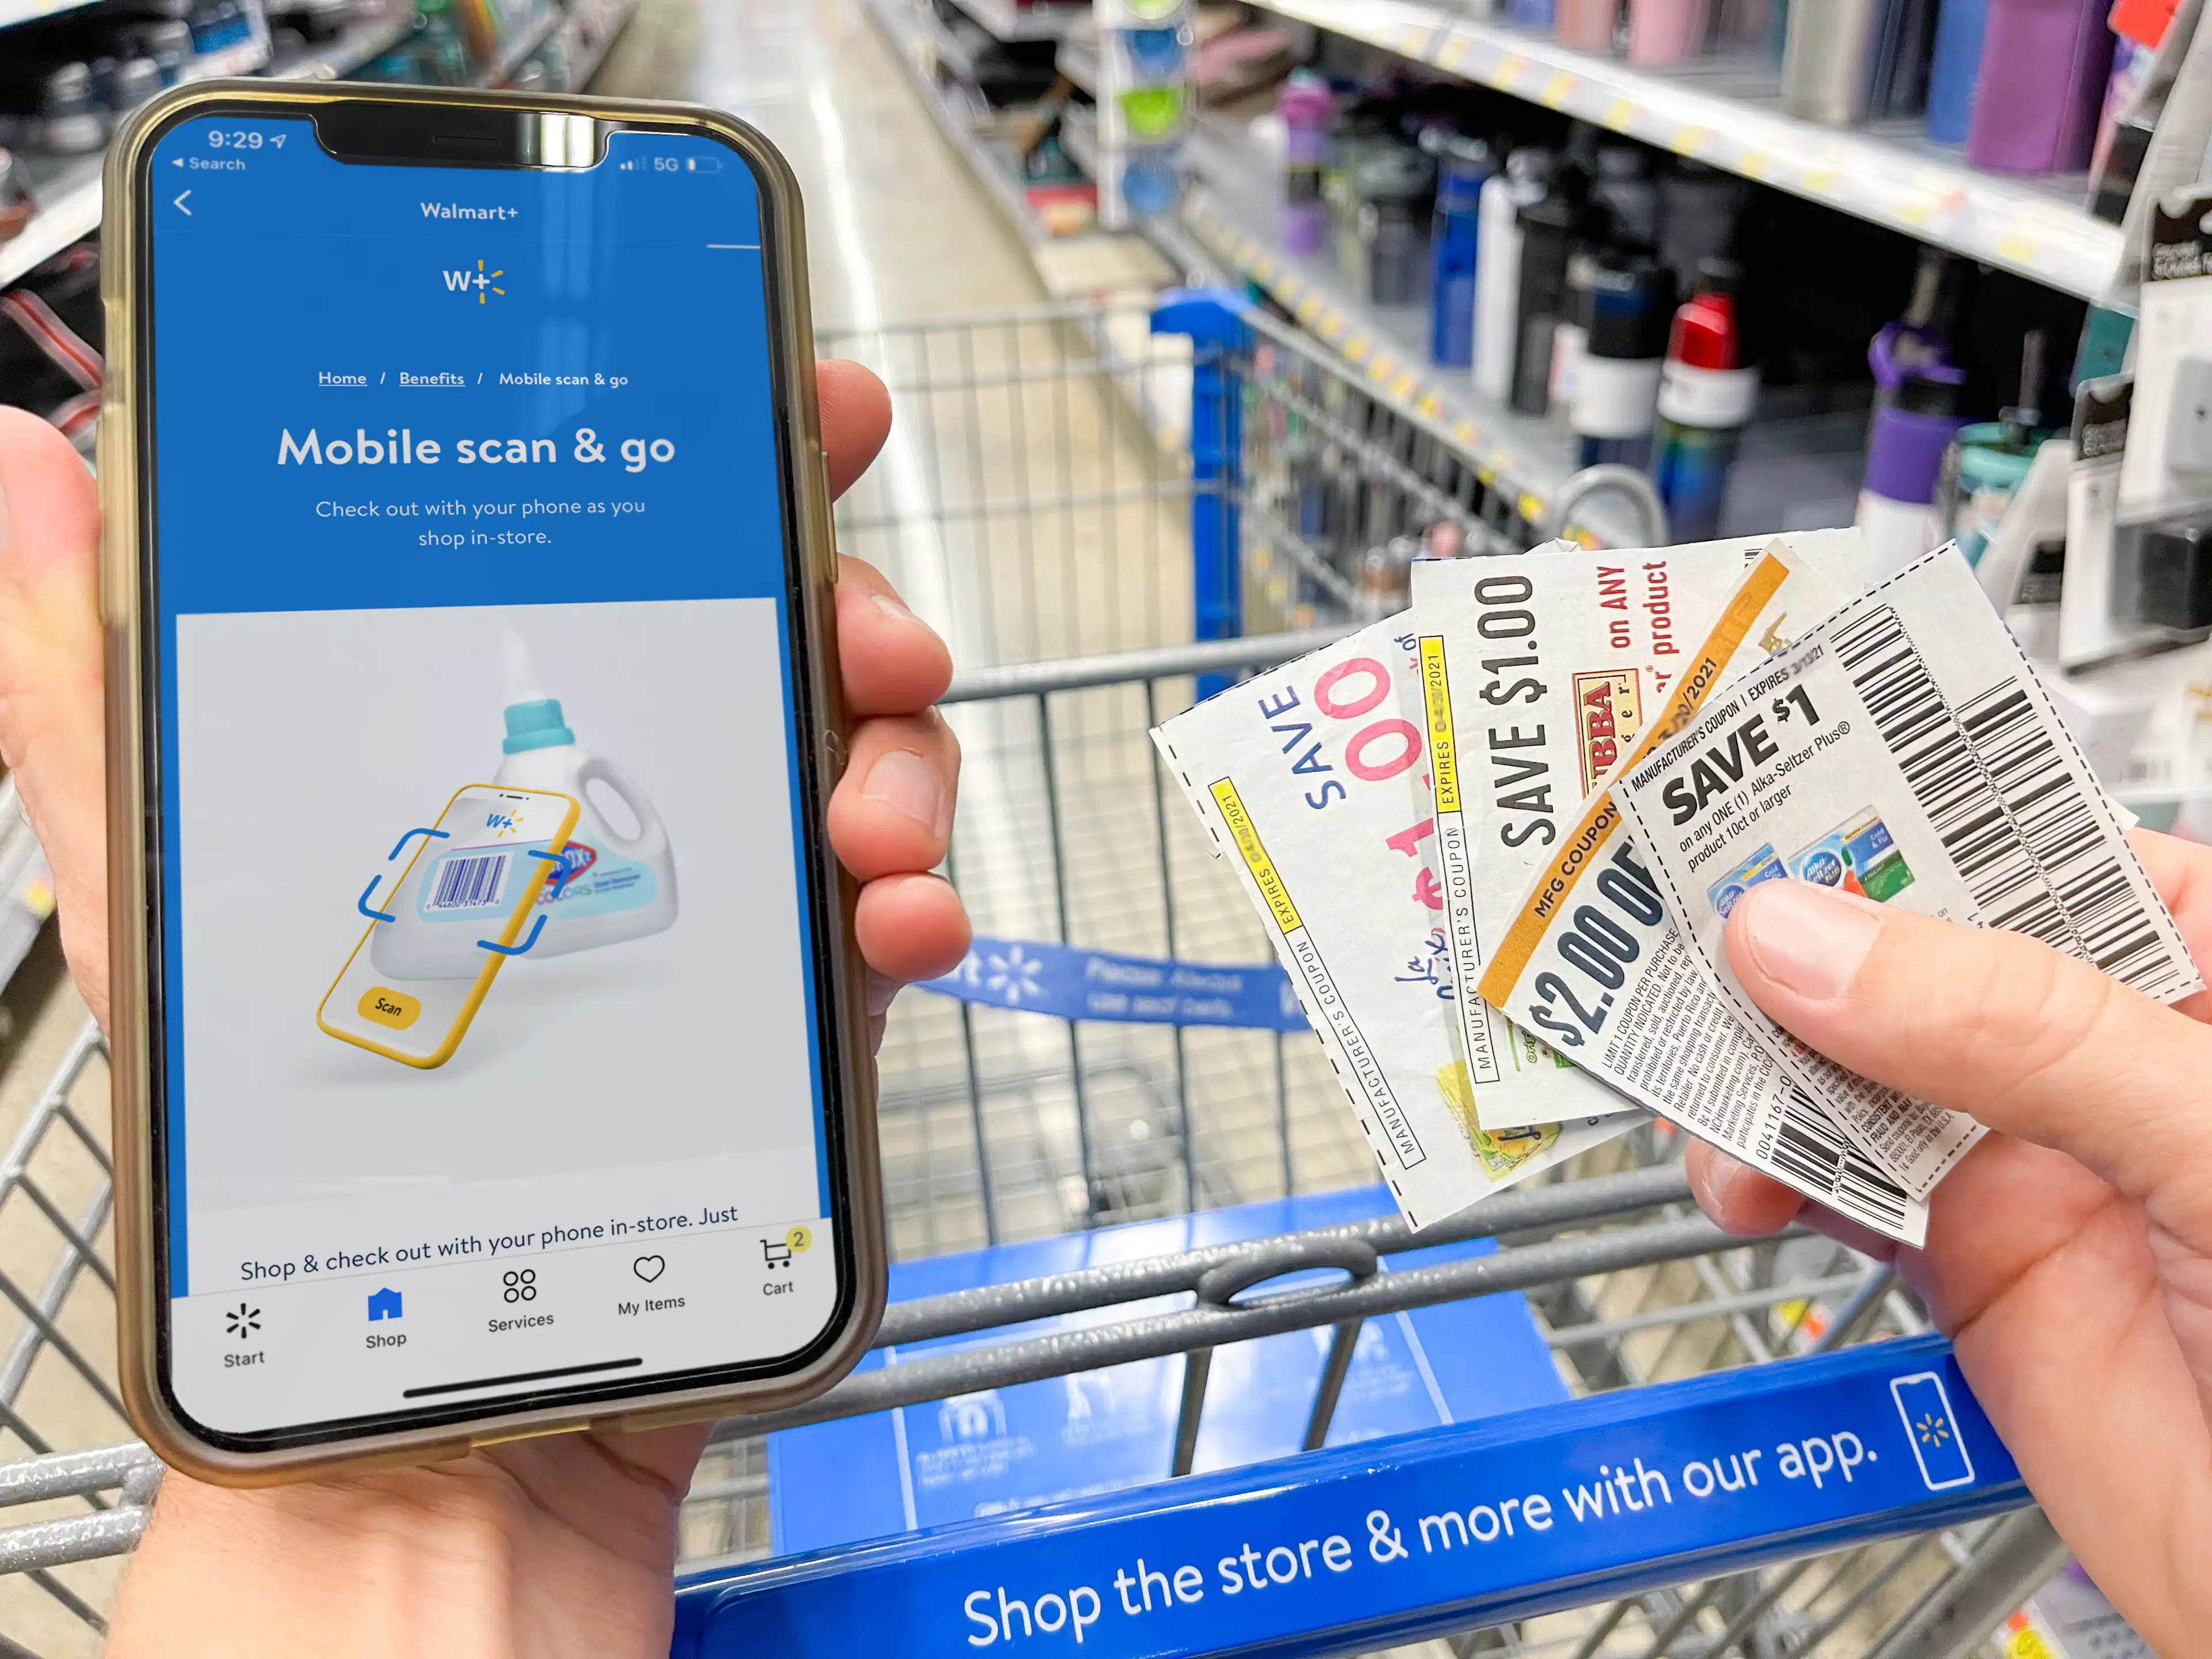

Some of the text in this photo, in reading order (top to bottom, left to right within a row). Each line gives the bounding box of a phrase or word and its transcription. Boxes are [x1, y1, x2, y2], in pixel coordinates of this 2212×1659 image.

[190, 157, 245, 170] Search
[209, 131, 263, 149] 9:29
[654, 157, 678, 171] 5G
[421, 203, 518, 219] Walmart+
[319, 372, 628, 388] Home Benefits Mobile scan & go
[278, 429, 675, 472] Mobile scan & go
[316, 499, 644, 519] Check out with your phone as you
[419, 530, 551, 550] shop in-store.
[1596, 566, 1629, 610] ANY
[1642, 560, 1680, 654] product
[1609, 620, 1631, 649] on
[1474, 575, 1556, 847] SAVE $1.00
[1631, 727, 1705, 791] MANUFACTURER'S
[1705, 700, 1740, 733] COUPON
[1748, 668, 1789, 701] EXPIRES
[1258, 685, 1346, 809] SAVE
[1440, 741, 1454, 805] EXPIRES
[1663, 714, 1779, 825] SAVE
[1772, 684, 1820, 726] $1
[1680, 837, 1693, 851] on
[1694, 821, 1711, 840] any
[1713, 801, 1734, 825] ONE
[1734, 791, 1748, 810] (1)
[1752, 746, 1813, 796] Alka-Seltzer
[1688, 785, 1790, 873] product 10ct or larger
[1446, 827, 1471, 899] COUPON
[1535, 801, 1618, 917] MFG COUPON
[1260, 869, 1294, 924] EXPIRES
[1297, 942, 1335, 1004] COUPON
[1528, 834, 1664, 1047] $2.00 OF
[375, 998, 402, 1016] Scan
[1457, 907, 1491, 1070] MANUFACTURER'S
[1602, 1041, 1619, 1068] LIMIT
[1618, 996, 1641, 1034] COUPON
[1635, 978, 1650, 997] PER
[1645, 928, 1679, 978] PURCHASE
[1615, 944, 1684, 1074] QUANTITY INDICATED. Not to be
[1627, 1036, 1654, 1082] transferred,
[1649, 1014, 1664, 1034] sold,
[1658, 972, 1684, 1013] auctioned,
[1641, 1046, 1662, 1091] prohibited
[1658, 1037, 1666, 1047] or
[1663, 997, 1684, 1036] restricted
[1679, 986, 1691, 997] by
[1652, 993, 1700, 1097] its territories, Puerto Rico
[1687, 1065, 1699, 1077] No
[1696, 1044, 1707, 1063] cash
[1704, 1032, 1711, 1043] or
[1708, 1007, 1724, 1032] credit
[1334, 1012, 1414, 1154] MANUFACTURER'S
[1663, 1028, 1701, 1104] the same shopping
[1688, 1016, 1736, 1119] returned to consumer. We
[1707, 1064, 1728, 1106] submitted
[1724, 1056, 1732, 1065] in
[1722, 1065, 1759, 1141] Marketing Services,
[1737, 1077, 1766, 1149] participates in the
[1870, 1123, 1888, 1143] FRAUD
[1887, 1109, 1900, 1126] AND
[241, 1207, 737, 1281] Shop & check out with your phone in-store. Just
[793, 1232, 804, 1247] 2
[489, 1315, 554, 1332] Services
[619, 1298, 685, 1316] My Items
[763, 1282, 793, 1296] Cart
[225, 1351, 264, 1368] Start
[366, 1335, 406, 1349] Shop
[965, 1432, 1877, 1646] Shop the store & more with our app.
